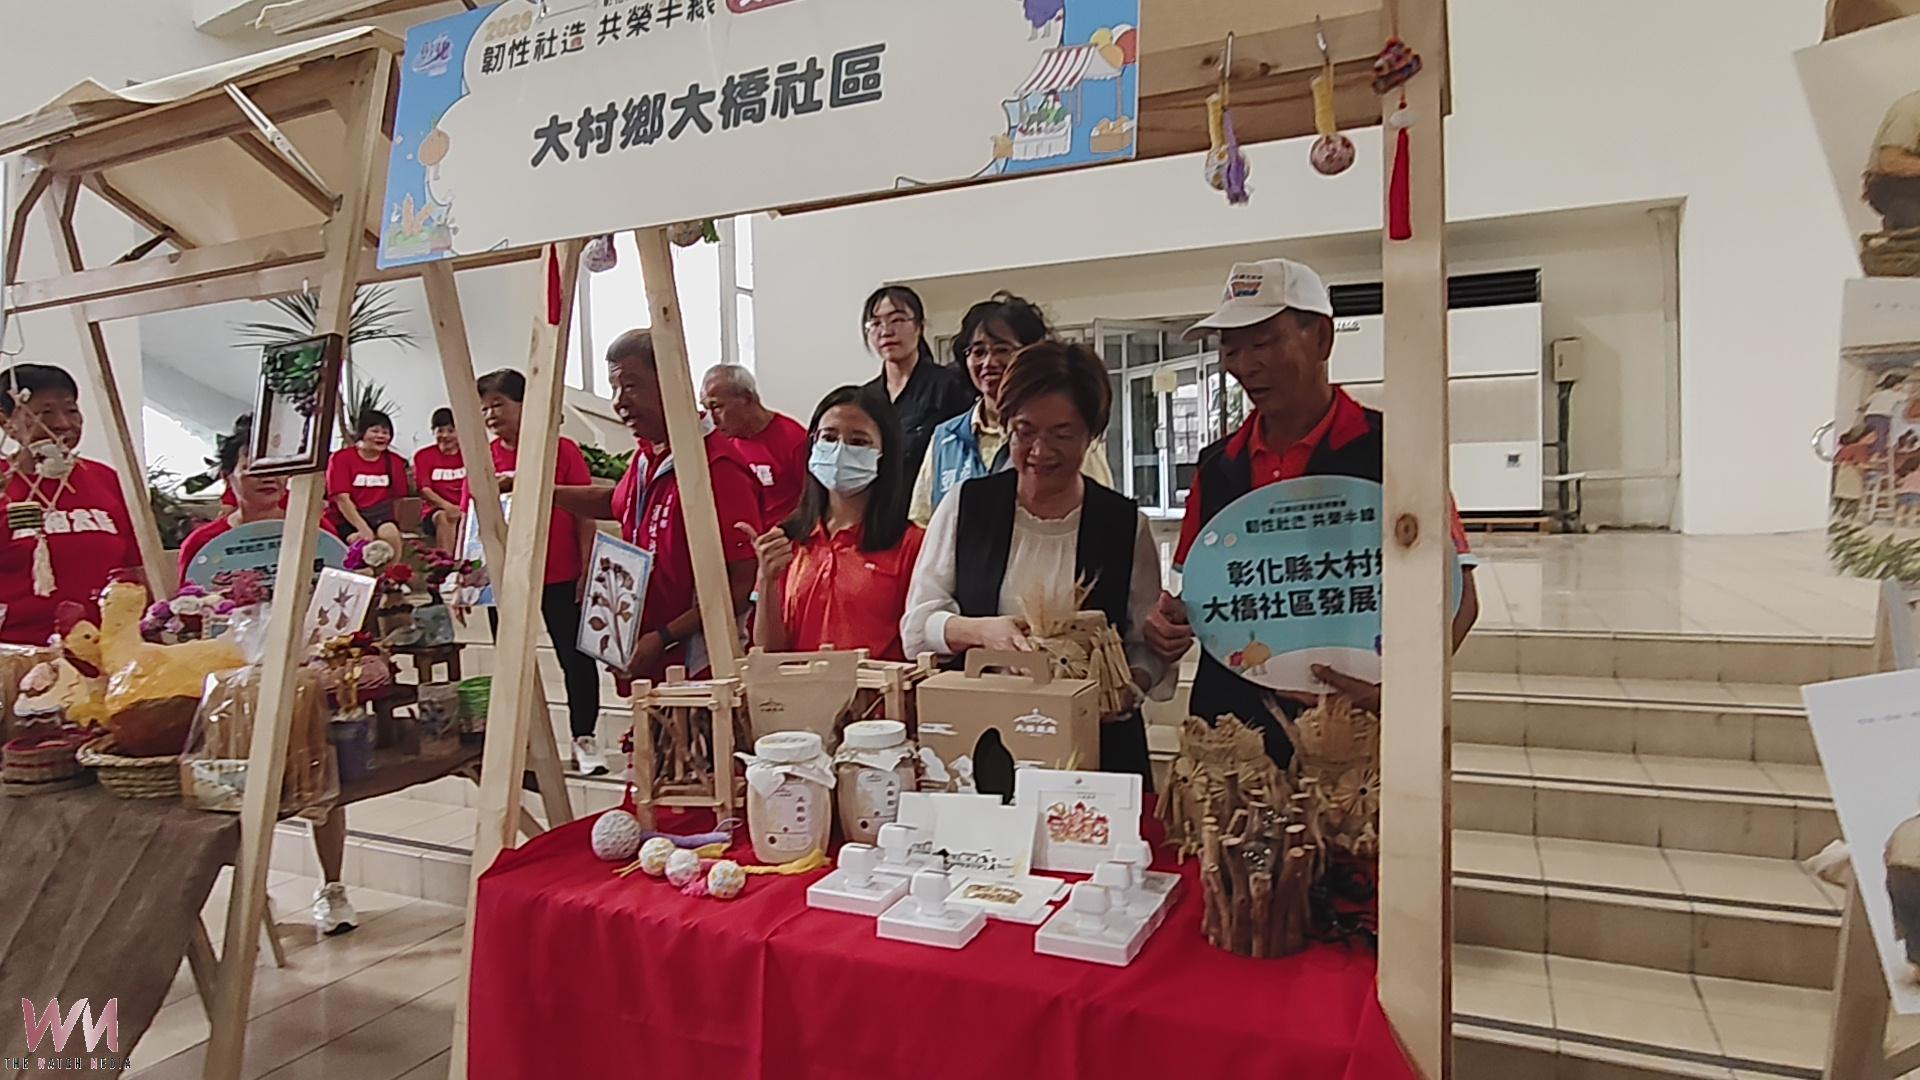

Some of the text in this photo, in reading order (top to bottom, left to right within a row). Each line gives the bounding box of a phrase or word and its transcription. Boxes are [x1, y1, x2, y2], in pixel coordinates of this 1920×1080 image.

[531, 42, 886, 168] 大村鄉大橋社區
[1202, 583, 1382, 624] 大橋社區發展
